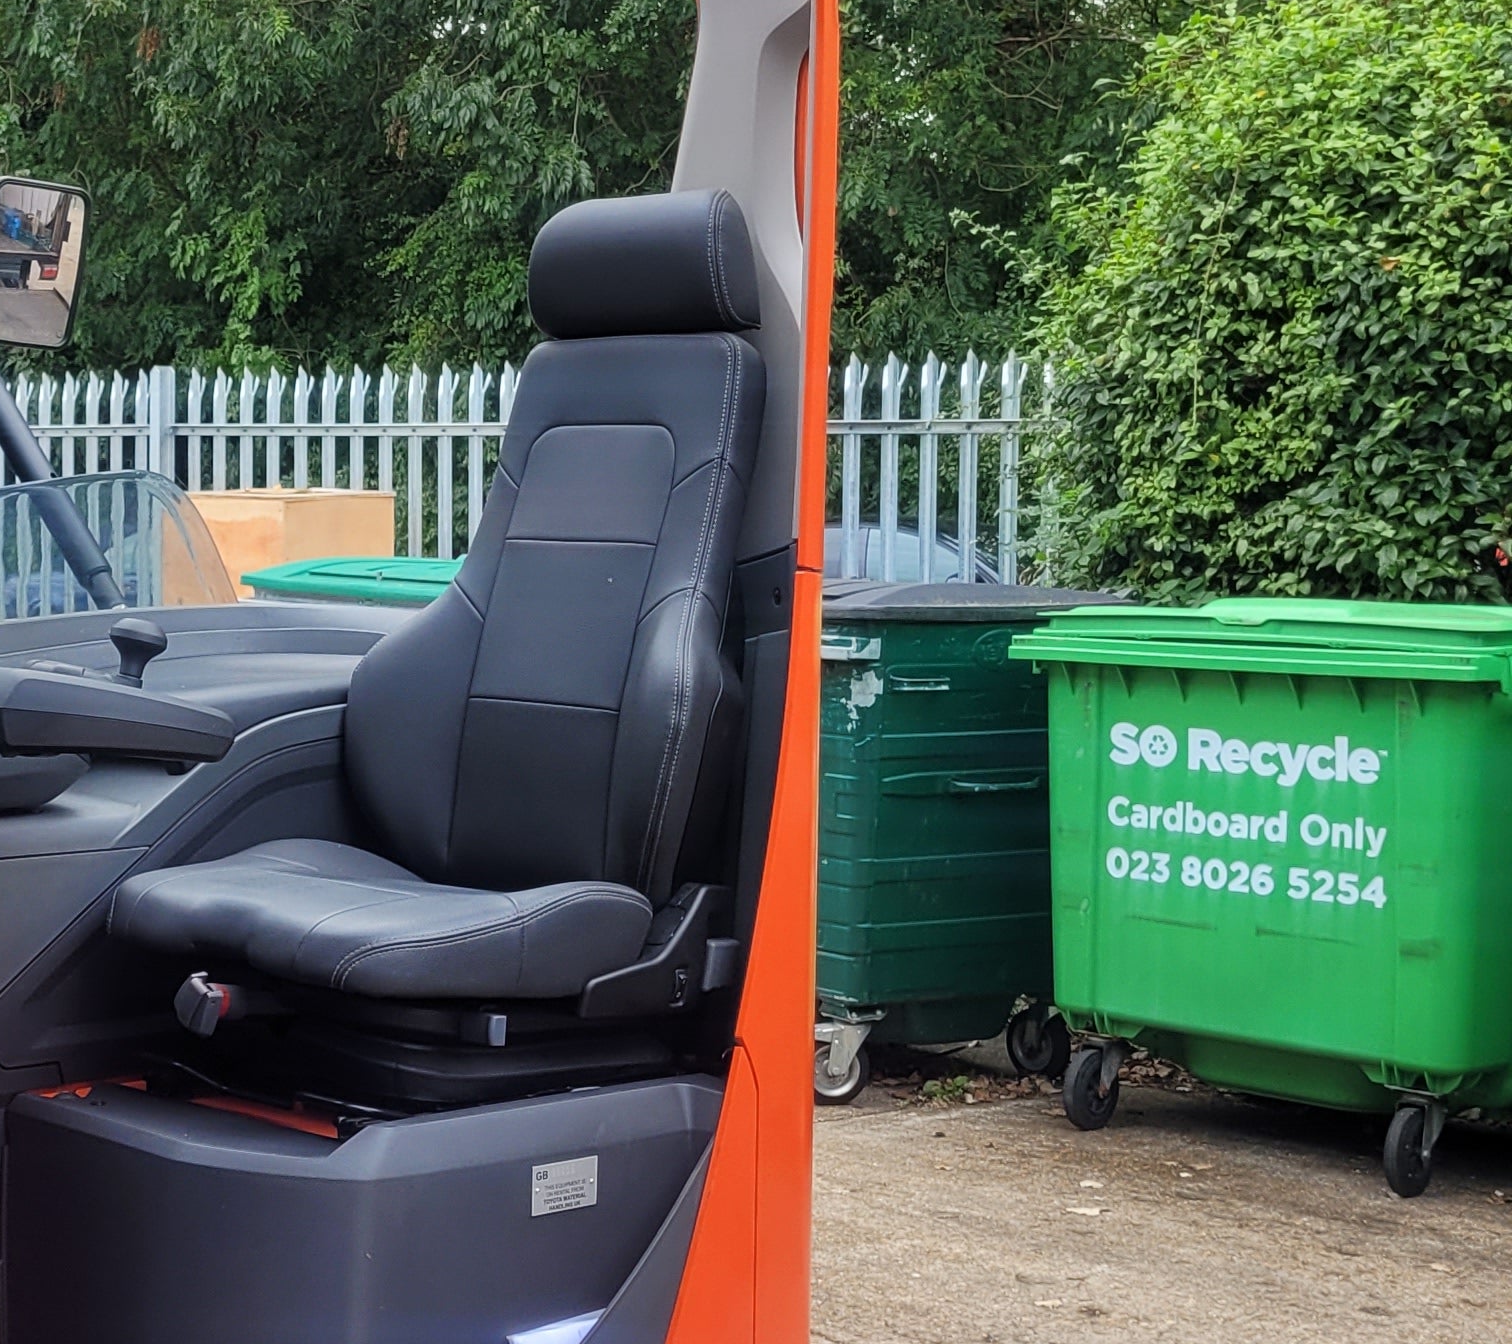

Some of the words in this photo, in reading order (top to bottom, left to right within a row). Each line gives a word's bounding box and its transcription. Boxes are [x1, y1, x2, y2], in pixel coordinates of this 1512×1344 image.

[1107, 796, 1288, 843] Cardboard
[1299, 813, 1387, 857] Only
[1105, 847, 1171, 884] 023
[1180, 856, 1275, 896] 8026
[1286, 867, 1387, 909] 5254
[536, 1170, 548, 1181] GB
